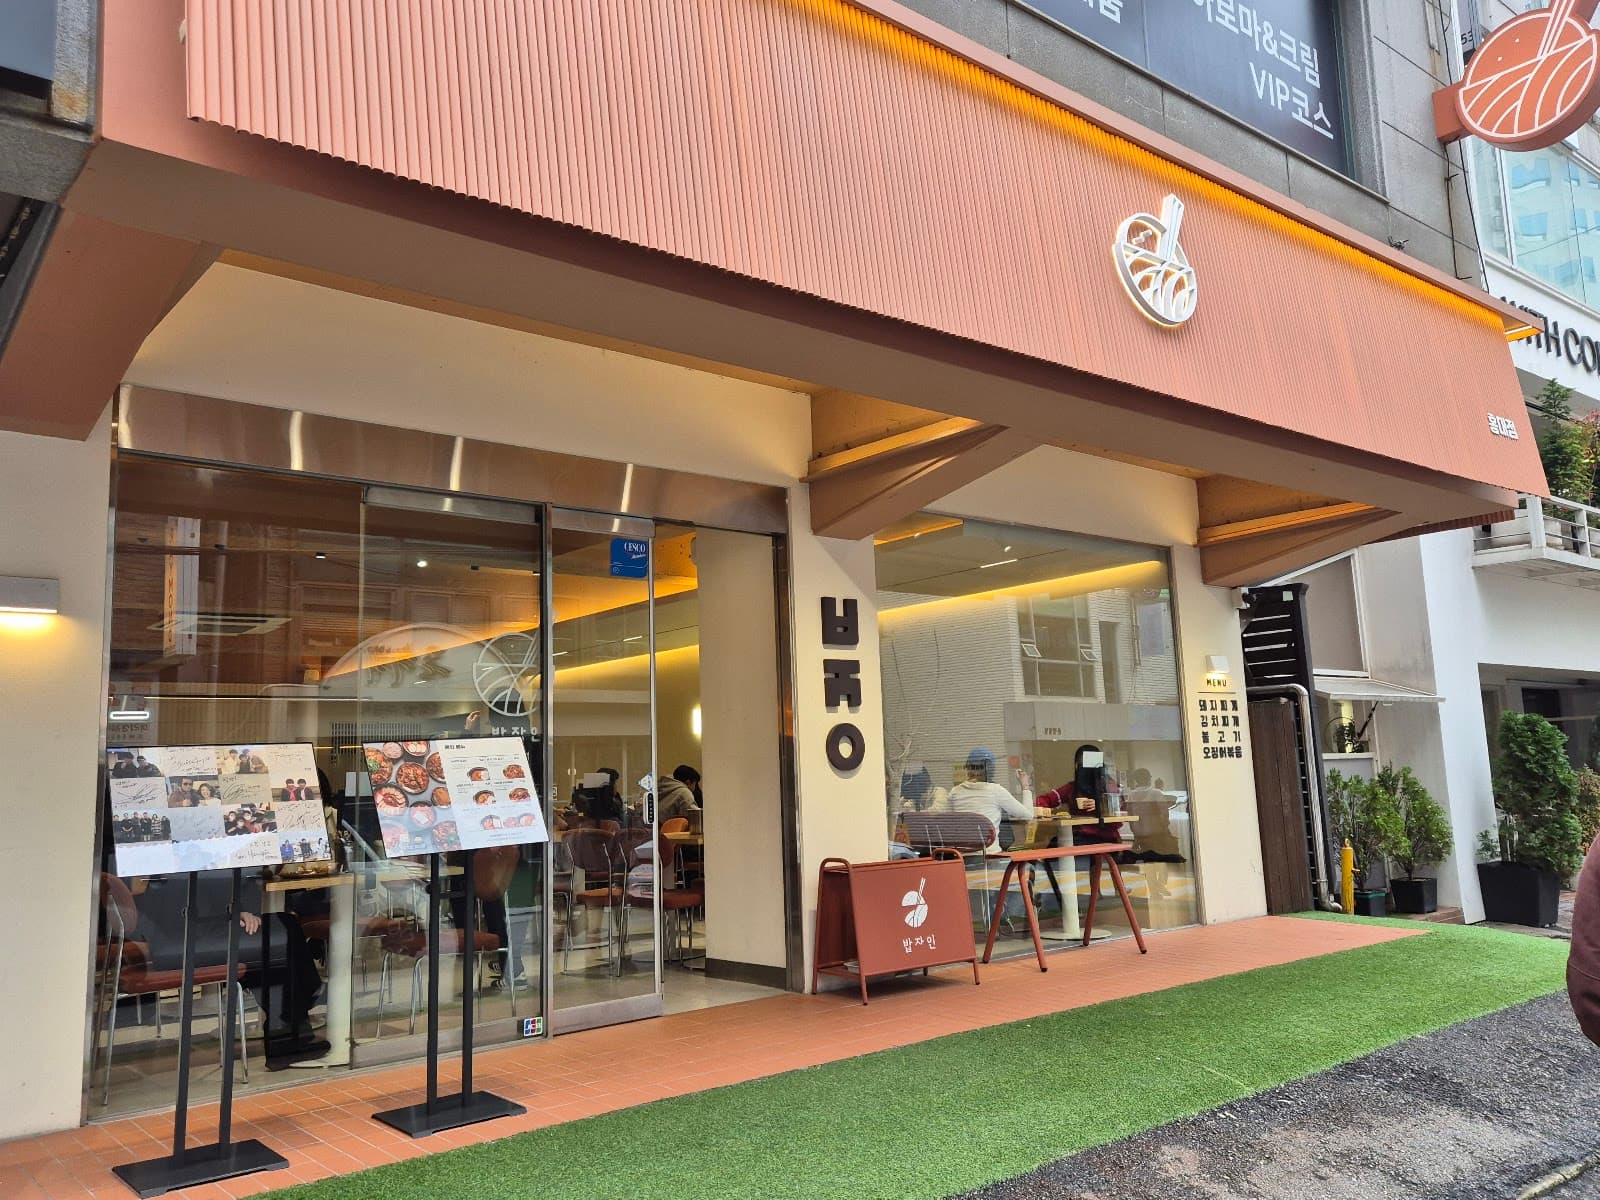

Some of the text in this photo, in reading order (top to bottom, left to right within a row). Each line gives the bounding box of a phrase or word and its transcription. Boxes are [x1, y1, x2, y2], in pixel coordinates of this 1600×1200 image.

[1249, 62, 1334, 140] VIP코스
[1206, 678, 1227, 687] MENU
[1202, 731, 1242, 744] 불고기
[902, 933, 937, 953] 밥자인
